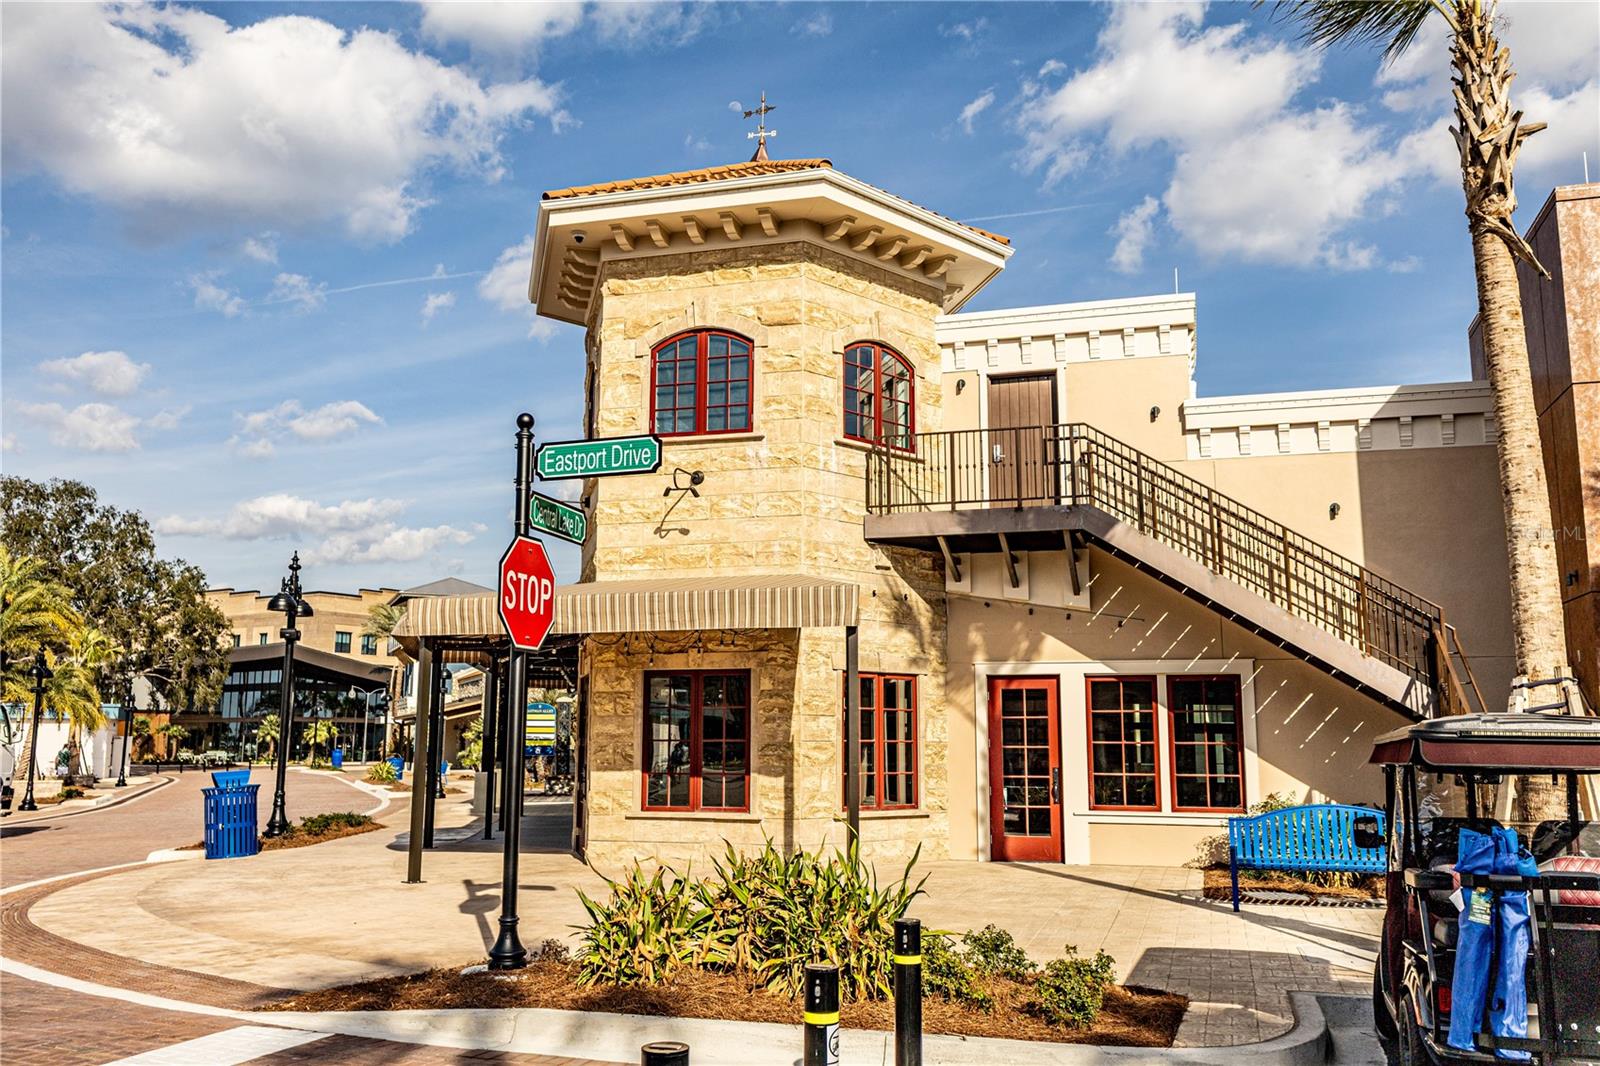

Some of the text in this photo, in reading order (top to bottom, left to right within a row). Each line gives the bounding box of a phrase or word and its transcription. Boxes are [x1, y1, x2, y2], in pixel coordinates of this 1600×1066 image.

[544, 443, 651, 474] Eastport Drive
[533, 500, 582, 537] Central Lake Dr
[505, 570, 552, 615] STOP
